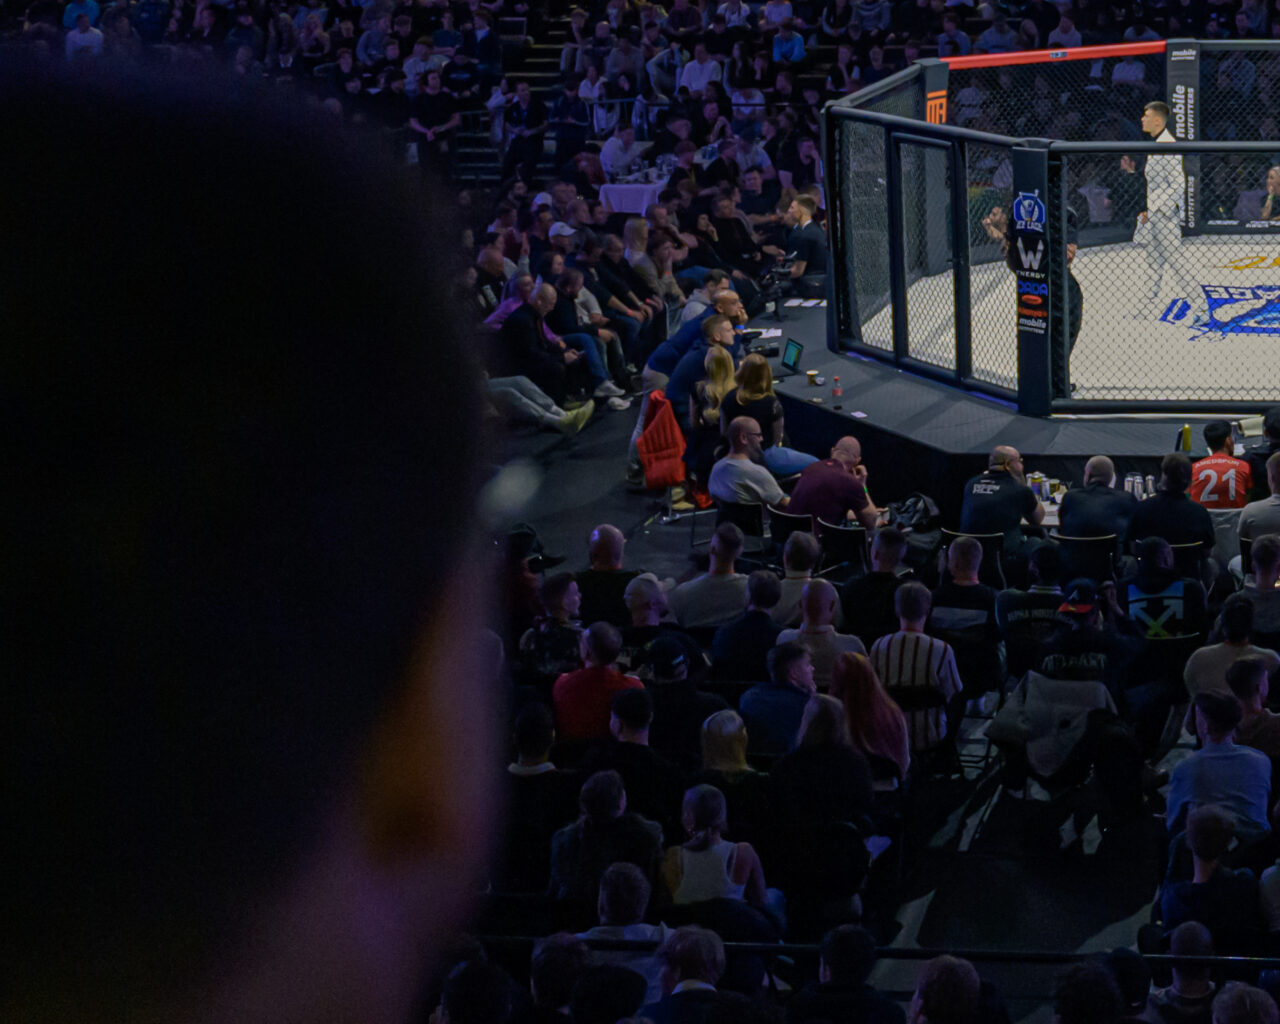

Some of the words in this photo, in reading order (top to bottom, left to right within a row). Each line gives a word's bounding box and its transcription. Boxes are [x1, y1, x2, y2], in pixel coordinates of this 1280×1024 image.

[1171, 84, 1186, 138] mobile
[1187, 87, 1195, 140] OUTFITTERS
[1017, 236, 1045, 271] W
[1199, 468, 1236, 502] 21
